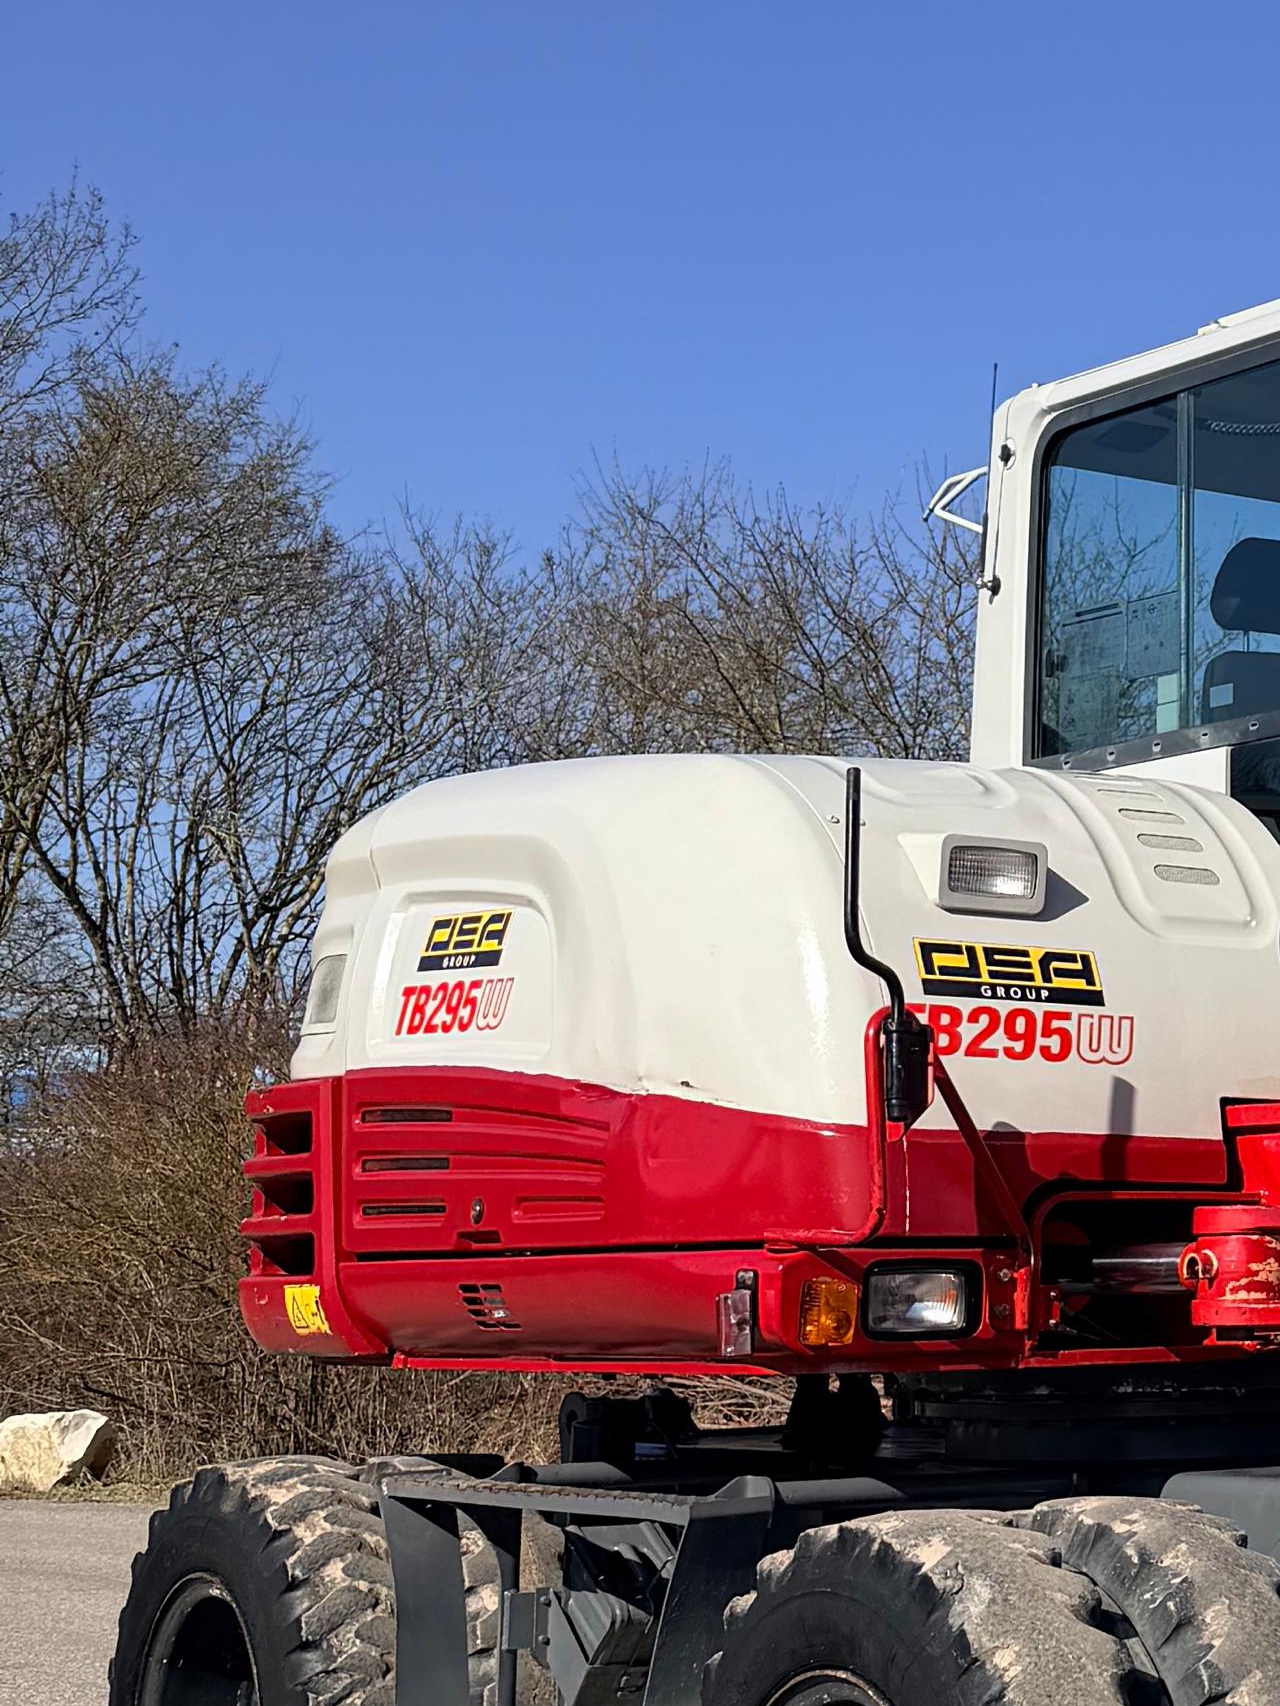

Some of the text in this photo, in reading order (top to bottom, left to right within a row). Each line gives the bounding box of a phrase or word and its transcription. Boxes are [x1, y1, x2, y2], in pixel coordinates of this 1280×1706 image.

[442, 954, 477, 968] GROUP
[395, 977, 515, 1036] TB295W
[980, 985, 1051, 1001] GROUP
[905, 1002, 1135, 1066] B295W
